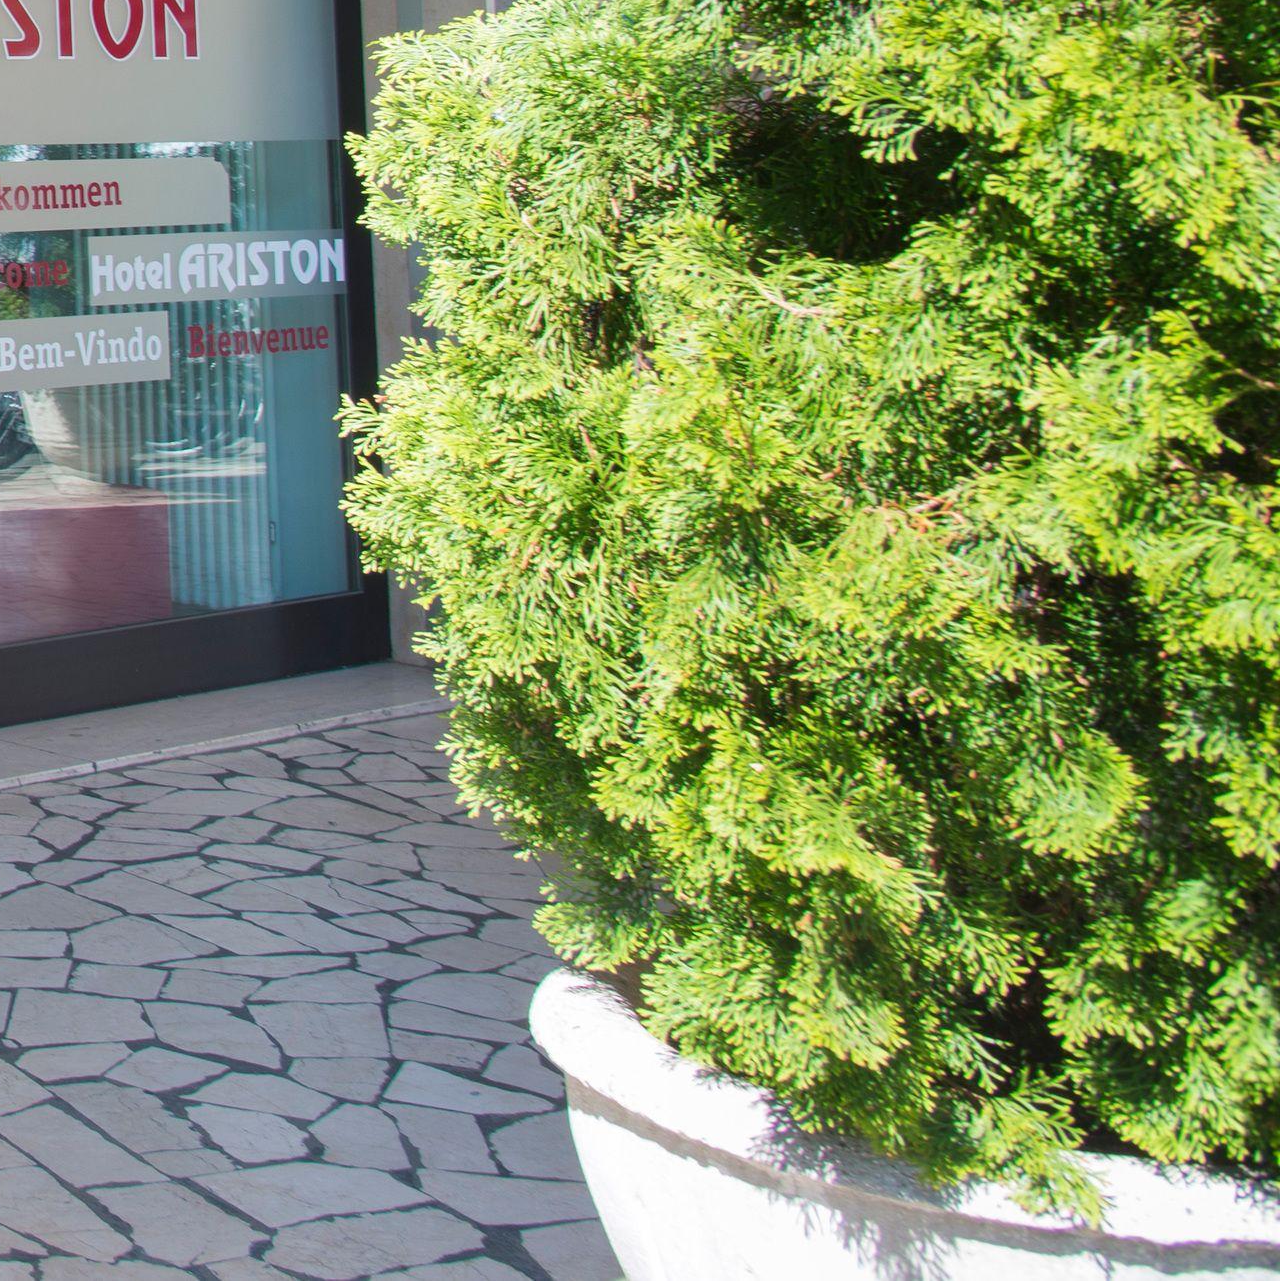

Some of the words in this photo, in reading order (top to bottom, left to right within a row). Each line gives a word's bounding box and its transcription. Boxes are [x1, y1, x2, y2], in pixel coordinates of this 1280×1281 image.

[92, 251, 172, 297] Hotel
[178, 237, 346, 295] ARISTON
[187, 324, 330, 359] Bienvenue
